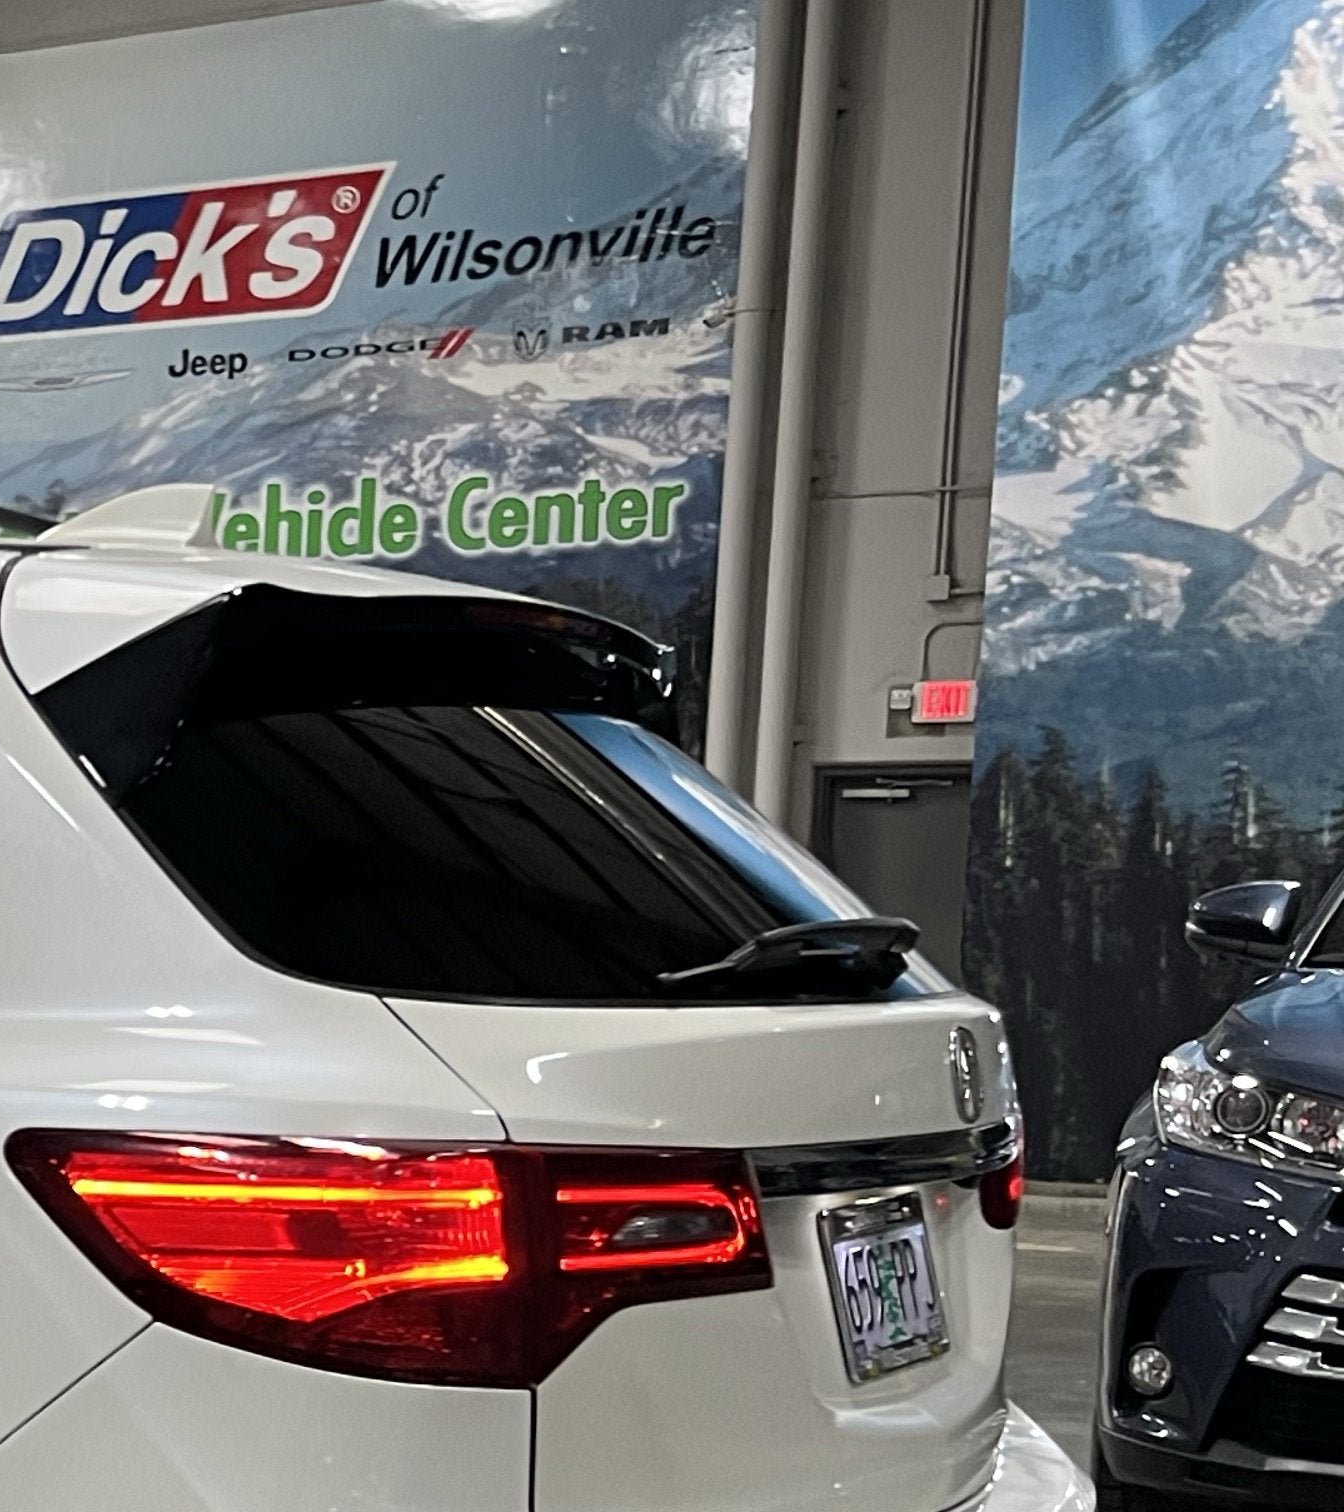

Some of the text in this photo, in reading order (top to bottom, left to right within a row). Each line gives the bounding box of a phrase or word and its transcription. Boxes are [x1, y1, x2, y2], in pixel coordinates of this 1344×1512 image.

[391, 173, 445, 220] of
[375, 205, 716, 288] Wilsonville
[563, 317, 671, 344] RAM
[168, 349, 247, 380] Jeep
[288, 337, 442, 362] DODGE
[448, 477, 685, 550] Center
[922, 682, 971, 718] EXIT
